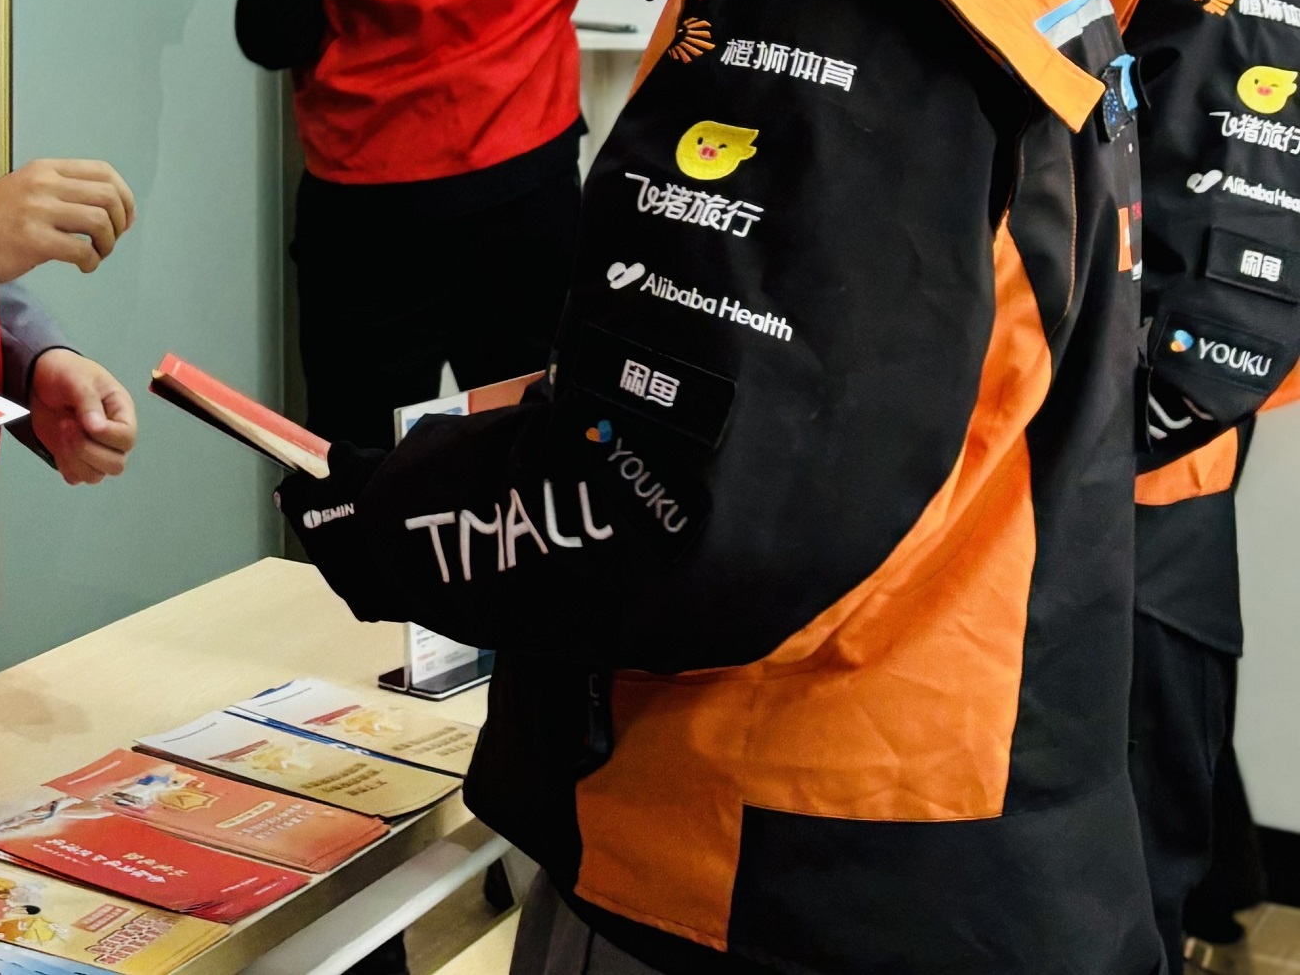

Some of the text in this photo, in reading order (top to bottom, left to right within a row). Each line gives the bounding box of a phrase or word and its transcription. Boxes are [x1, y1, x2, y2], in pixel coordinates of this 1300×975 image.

[720, 38, 858, 92] 橙狮体育
[1208, 110, 1300, 155] 飞猪旅行
[624, 172, 765, 238] 飞猪旅行
[1222, 175, 1275, 204] Alibaba
[1240, 249, 1282, 282] 闲鱼
[640, 272, 793, 341] Alibaba Health
[619, 358, 681, 408] 闲鱼
[1199, 337, 1273, 378] YOUKU
[607, 437, 689, 533] YOUKU
[405, 478, 614, 583] TMALL
